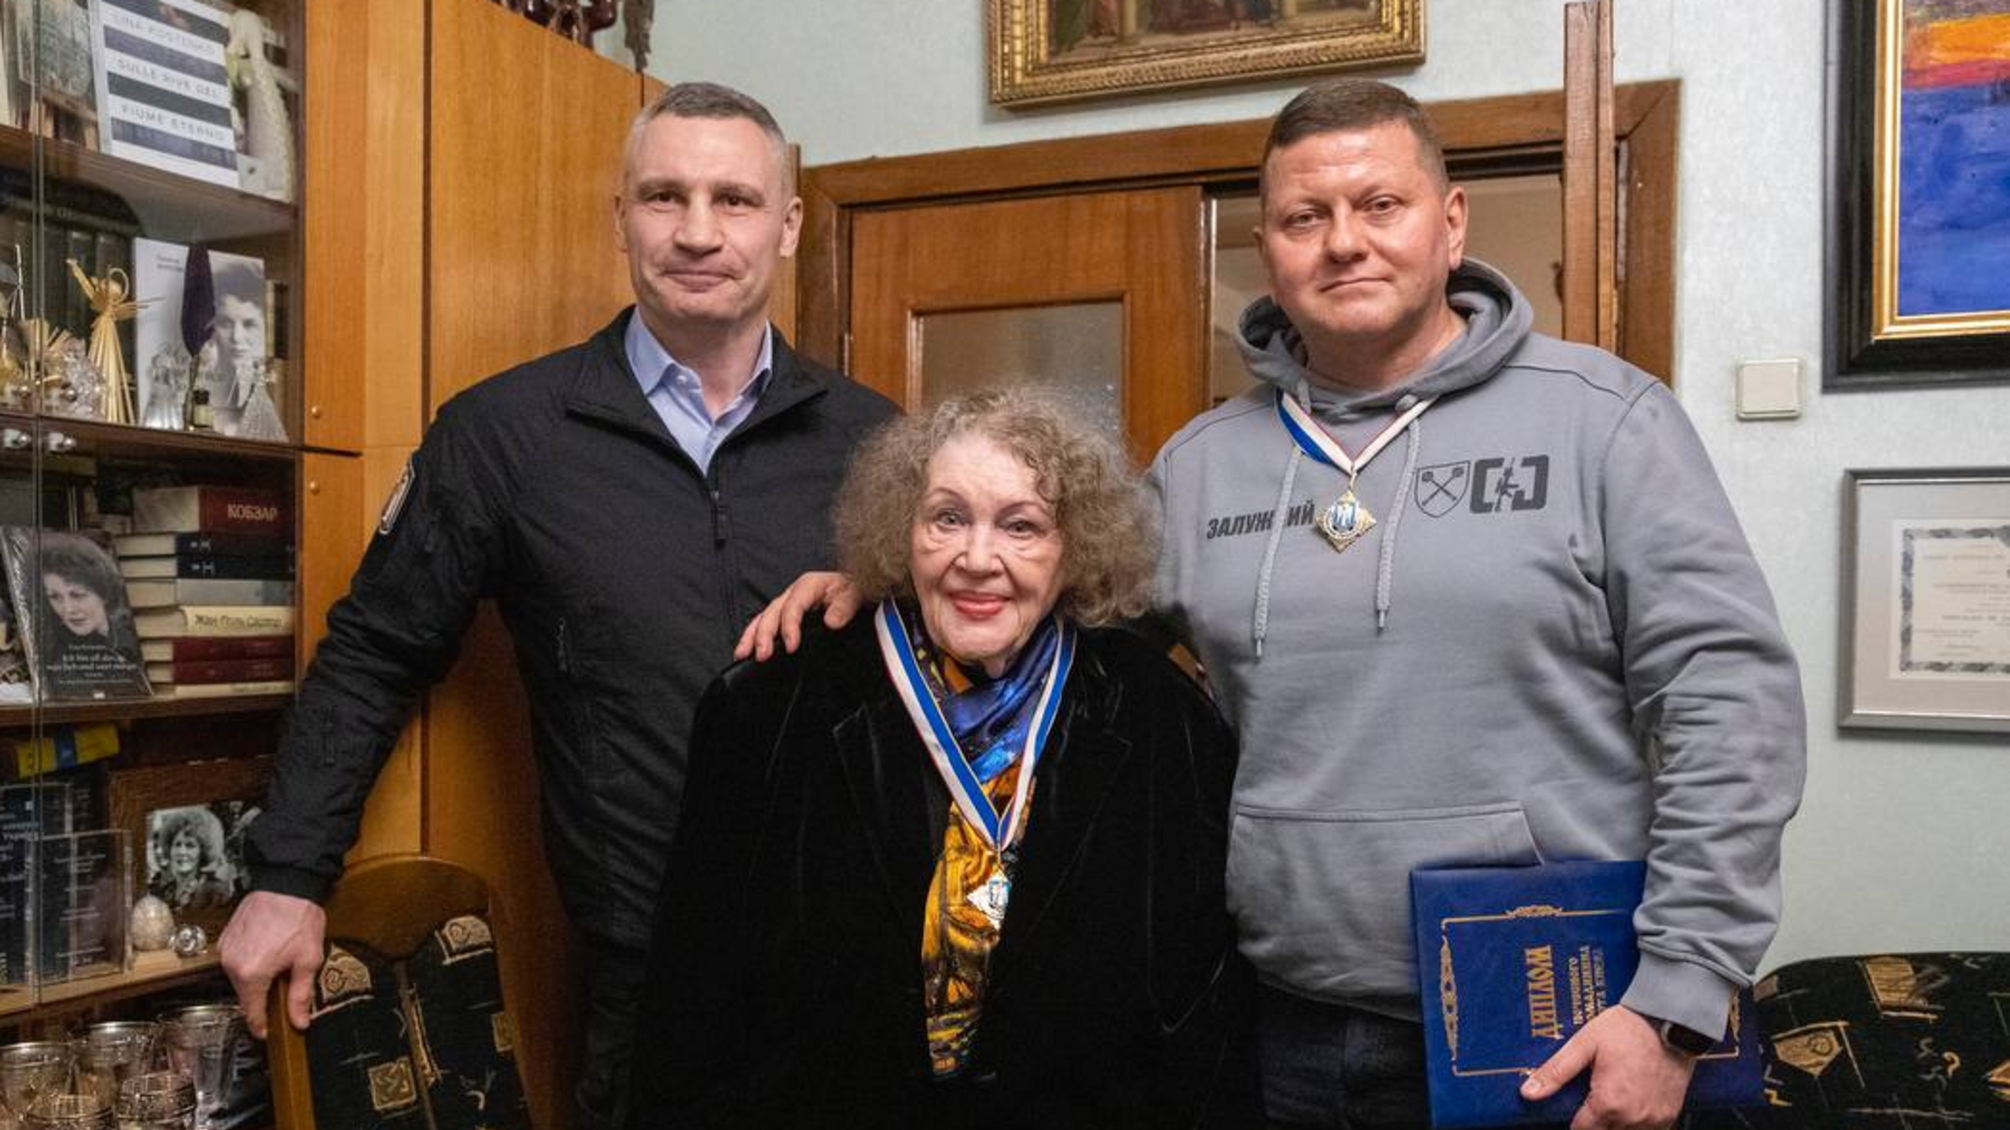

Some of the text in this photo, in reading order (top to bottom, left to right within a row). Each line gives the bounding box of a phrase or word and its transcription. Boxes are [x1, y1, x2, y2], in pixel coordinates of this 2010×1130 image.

[118, 58, 156, 80] SULLE
[122, 103, 225, 142] FIUME ETERNO
[227, 503, 279, 522] КОБЗАР
[1206, 500, 1315, 539] ЗАЛУЖИЙ
[1525, 945, 1564, 1039] ДИПЛОМ
